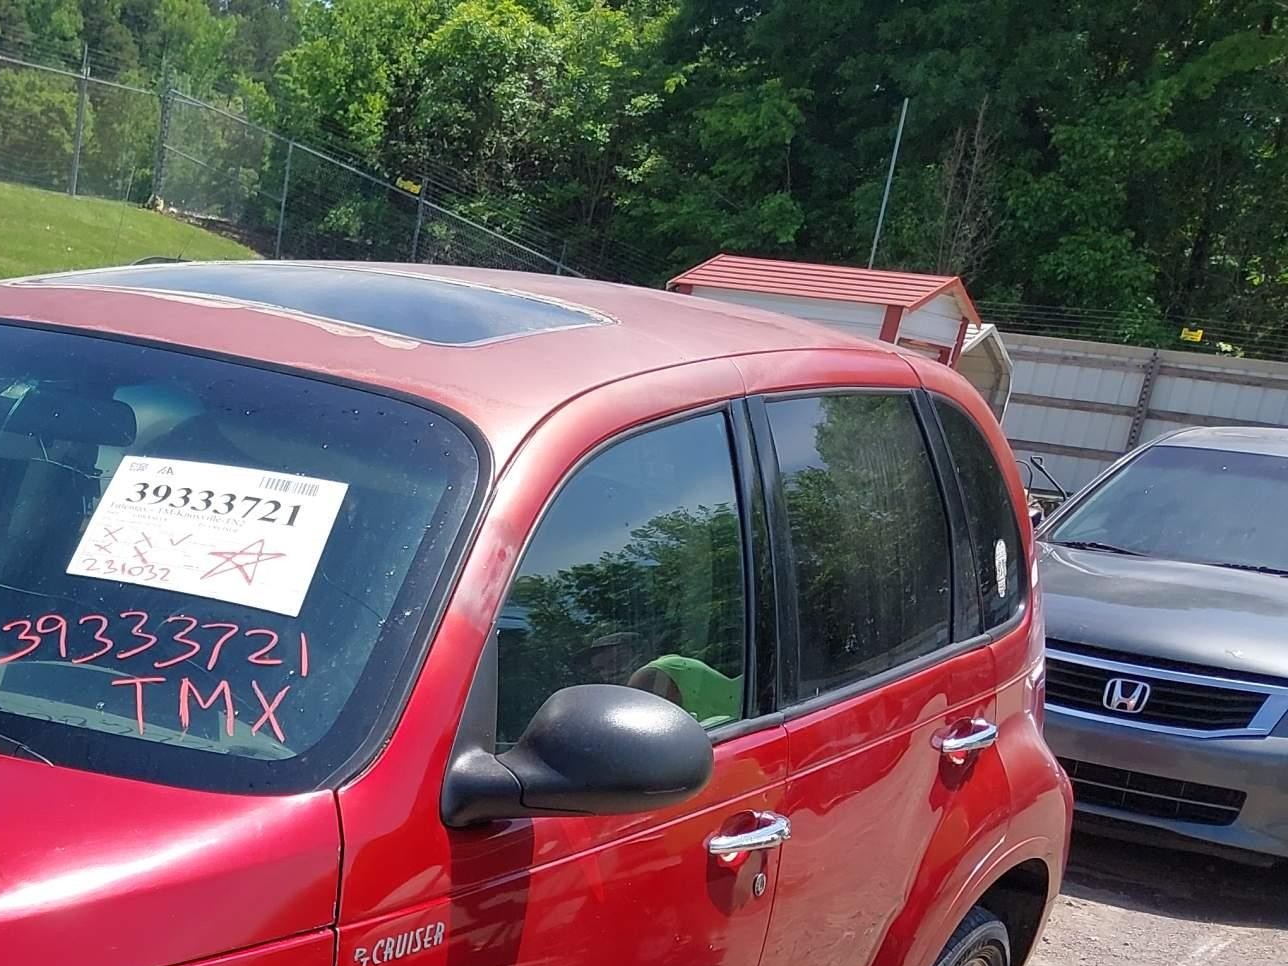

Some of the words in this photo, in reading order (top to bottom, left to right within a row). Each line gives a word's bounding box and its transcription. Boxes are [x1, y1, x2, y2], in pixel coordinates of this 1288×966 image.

[125, 482, 302, 528] 39333721
[81, 558, 172, 582] 231032
[111, 677, 291, 744] TMX
[372, 921, 446, 965] CRUISER
